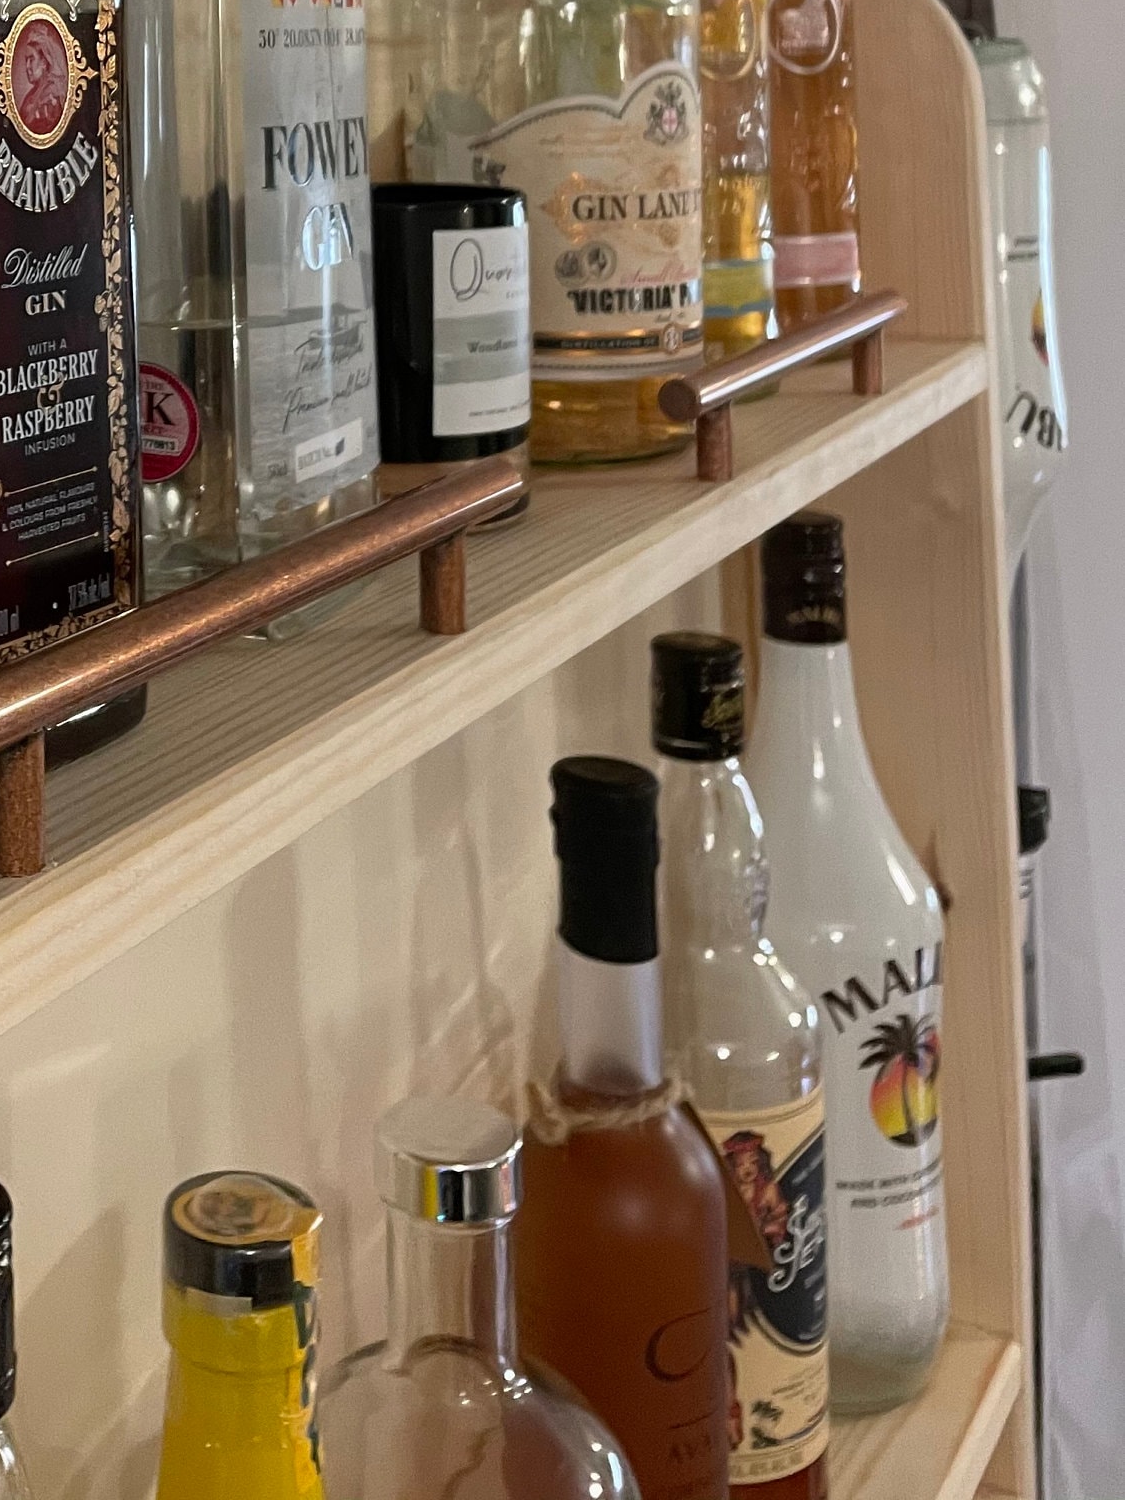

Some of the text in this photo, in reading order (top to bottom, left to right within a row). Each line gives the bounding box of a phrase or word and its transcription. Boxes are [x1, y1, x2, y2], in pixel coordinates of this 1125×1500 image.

[571, 192, 629, 222] GIN
[637, 190, 690, 220] LANE
[1, 243, 88, 290] Distilled
[25, 289, 67, 316] GIN
[27, 339, 68, 356] WITH A
[1, 395, 96, 444] RASPBERRY
[24, 433, 76, 456] INFUSION
[45, 504, 67, 518] FROM
